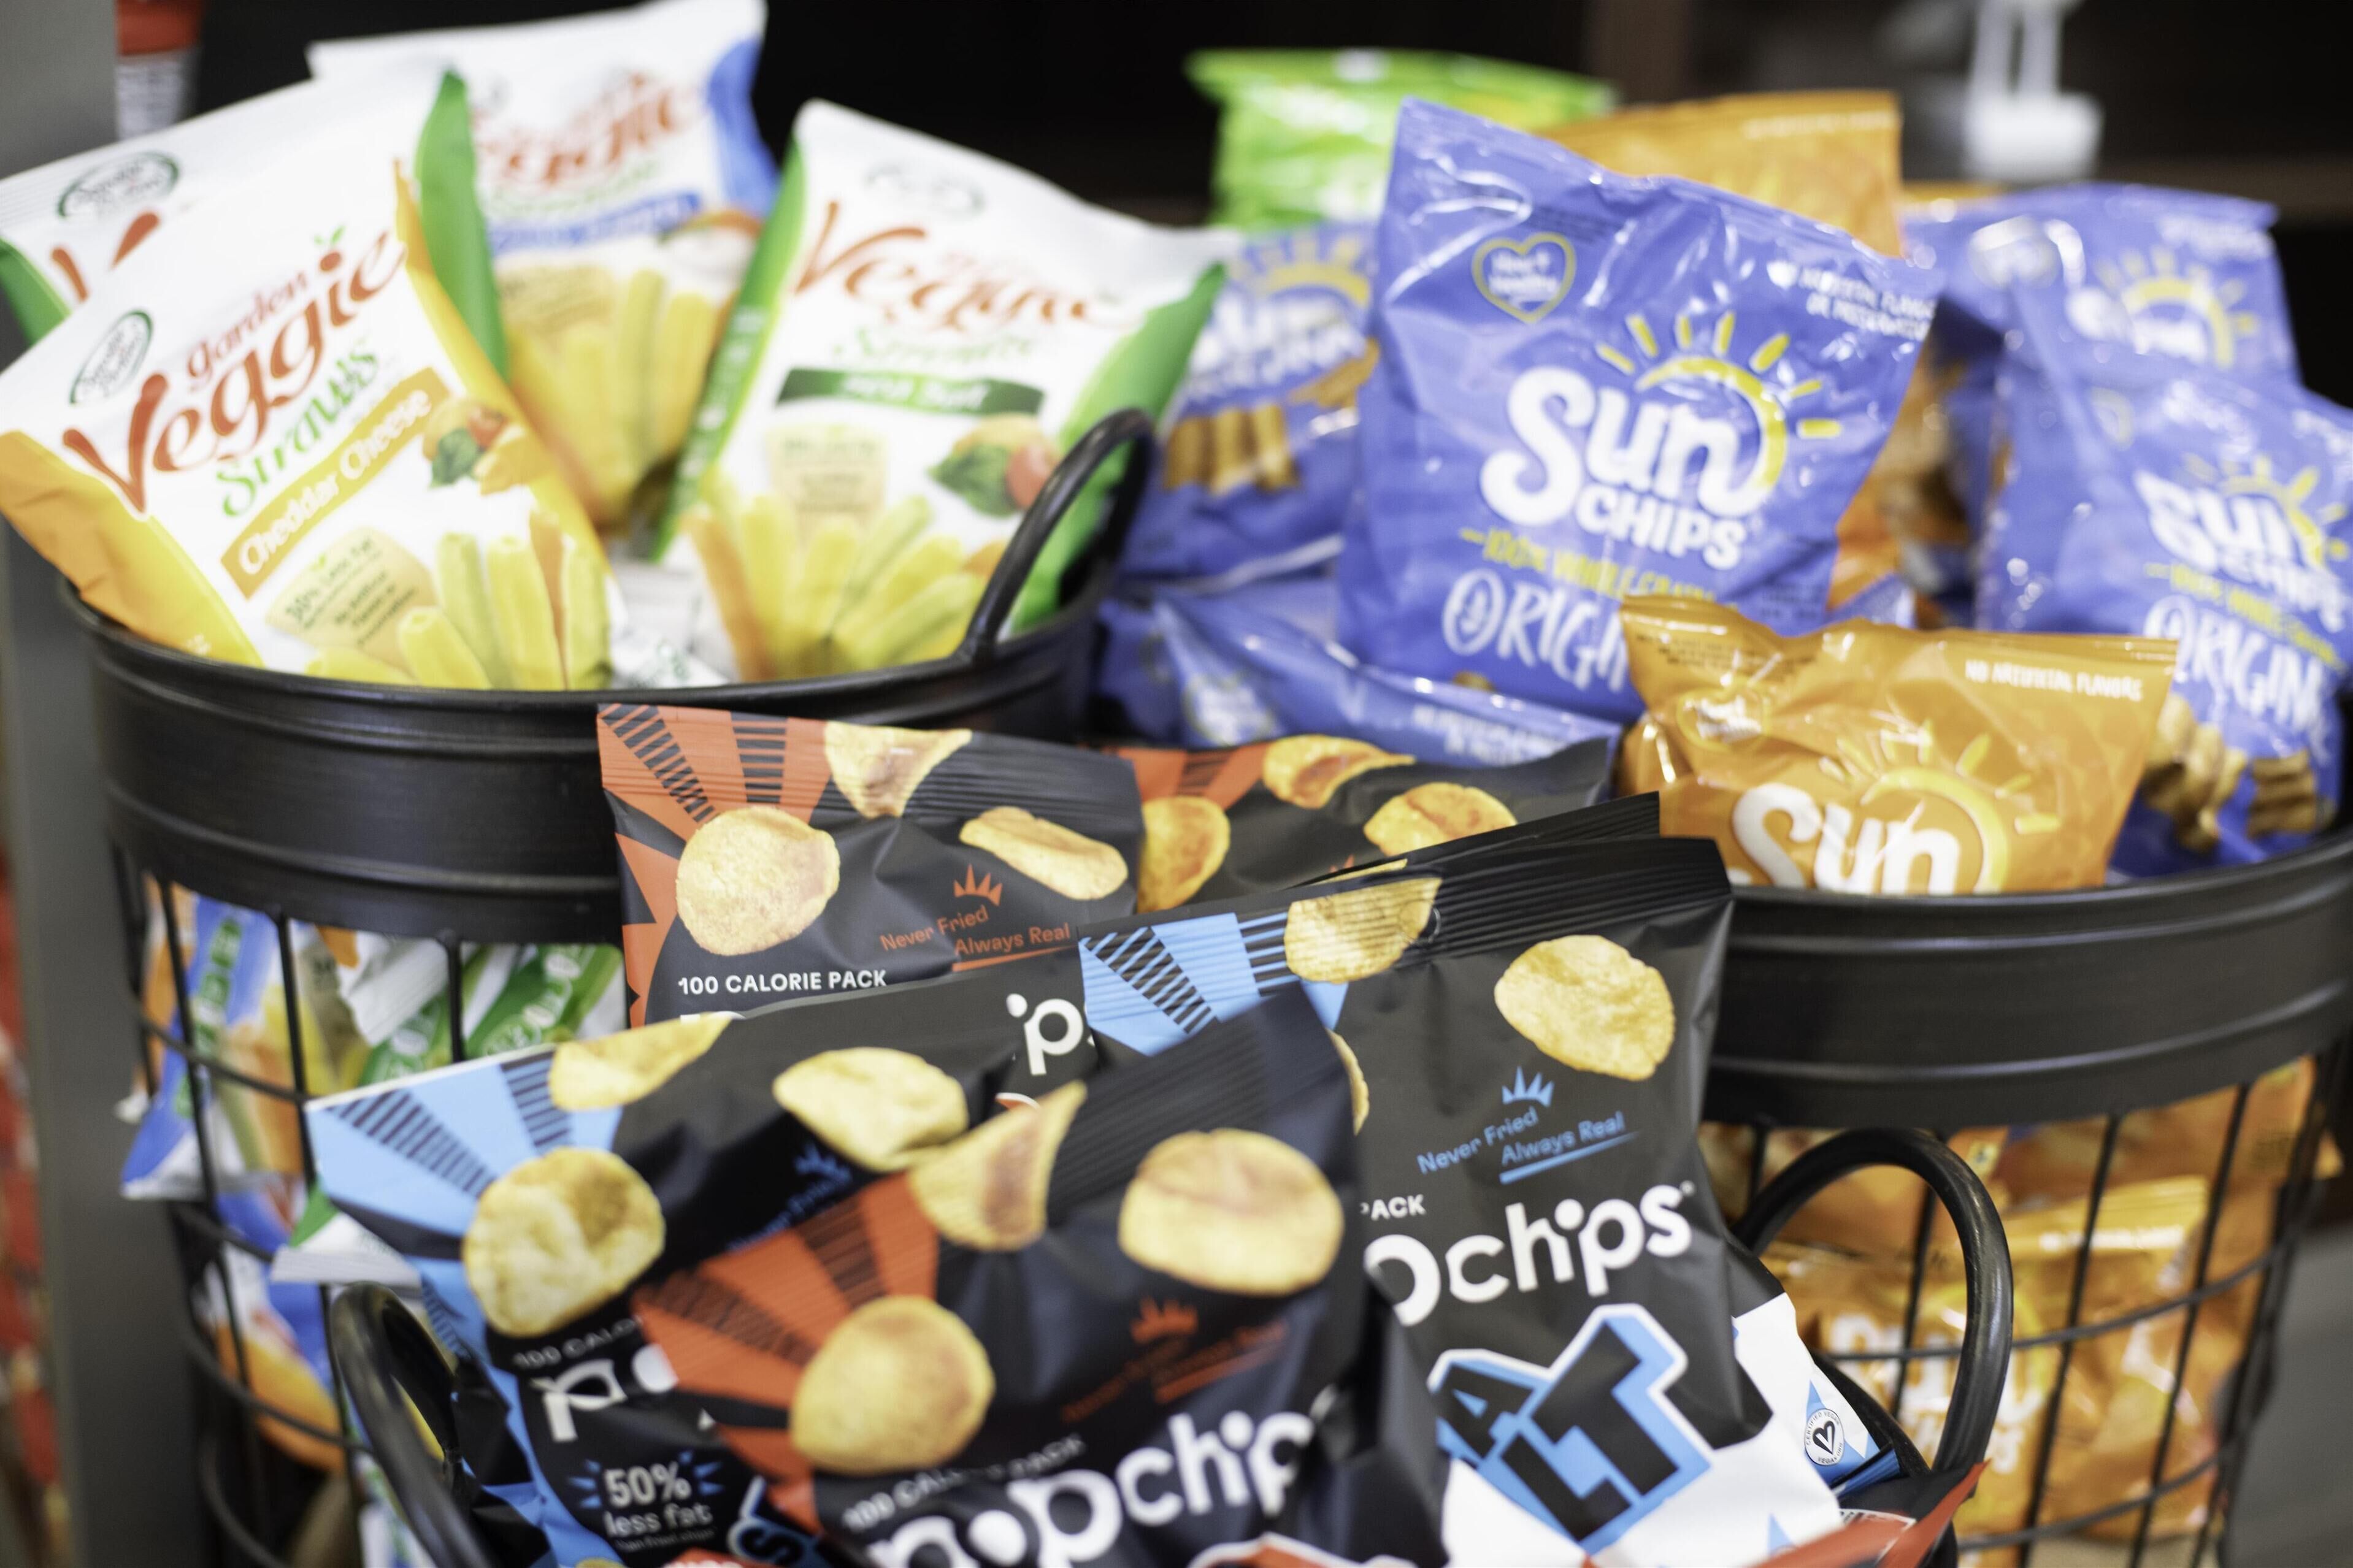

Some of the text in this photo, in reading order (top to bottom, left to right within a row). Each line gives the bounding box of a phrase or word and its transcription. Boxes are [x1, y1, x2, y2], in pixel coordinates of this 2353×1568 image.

[186, 270, 309, 392] garden
[63, 231, 408, 515] Veggie
[1480, 367, 1776, 527] Sun
[239, 389, 432, 575] Cheddar Cheese
[1575, 480, 1747, 571] CHIPS
[1965, 658, 1989, 684] NO
[2076, 671, 2141, 702] FLAVORS
[879, 904, 990, 952] Never Fried
[954, 922, 1071, 957] Always Real
[678, 969, 888, 995] 100 CALORIE PACK
[1416, 1105, 1539, 1175] Never Fried
[1501, 1109, 1626, 1166] Always Real
[1360, 1193, 1427, 1221] ACK
[1805, 1410, 1841, 1446] CERTIFIED VEGAN
[603, 1461, 693, 1509] 50%
[602, 1502, 713, 1537] less fat
